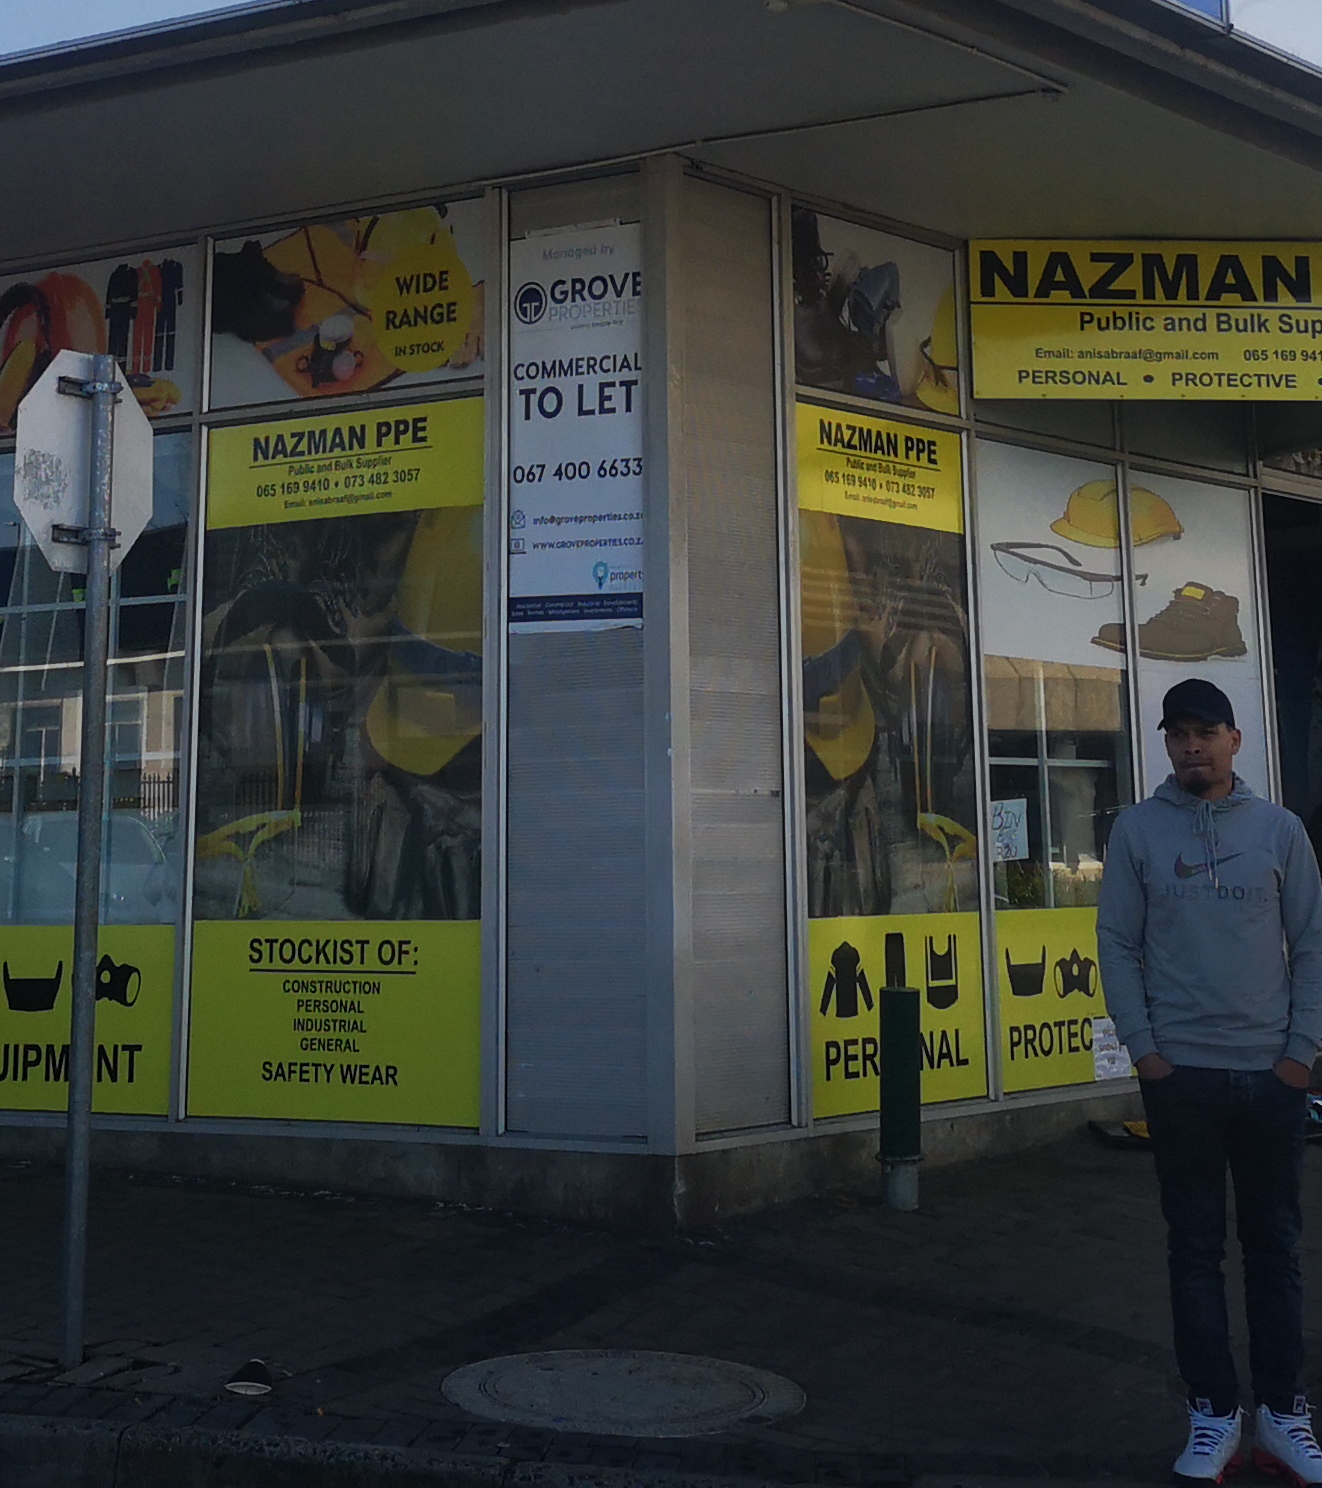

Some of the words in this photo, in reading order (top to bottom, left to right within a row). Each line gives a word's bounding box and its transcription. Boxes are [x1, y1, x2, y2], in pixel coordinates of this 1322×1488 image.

[542, 244, 597, 261] Managed
[600, 243, 615, 256] by
[395, 270, 449, 296] WIDE
[550, 271, 641, 305] GROVE
[980, 250, 1312, 304] NAZMAN
[385, 302, 458, 331] RANGE
[1079, 311, 1155, 332] Public
[1163, 313, 1206, 332] and
[1216, 313, 1270, 333] Bulk
[394, 344, 407, 357] IN
[410, 340, 445, 356] STOCK
[1035, 348, 1073, 360] Email:
[1077, 348, 1219, 362] anisabraaf@gmail.com
[1243, 349, 1268, 361] 065
[1273, 350, 1296, 361] 169
[513, 352, 642, 381] COMMERCIAL
[1018, 369, 1128, 386] PERSONAL
[1172, 372, 1297, 389] PROTECTIVE
[519, 385, 563, 421] TO
[577, 379, 639, 417] LET
[253, 424, 366, 462] NAZMAN
[376, 416, 428, 448] PPE
[819, 418, 899, 459] NAZMAN
[904, 435, 938, 465] PPE
[288, 463, 315, 476] Public
[317, 461, 333, 473] and
[335, 459, 353, 471] Bulk
[356, 455, 392, 470] Supplier
[513, 463, 546, 483] 067
[553, 461, 590, 481] 400
[597, 457, 643, 479] 6633
[256, 483, 277, 498] 065
[281, 482, 300, 495] 169
[303, 478, 330, 493] 9410
[344, 475, 365, 489] 073
[368, 472, 389, 486] 482
[393, 468, 421, 483] 3057
[858, 475, 876, 490] 9410
[885, 480, 900, 494] 073
[532, 537, 643, 550] WWW.GROVEPROPERTIES.CO.Z
[610, 570, 643, 583] propert
[1218, 885, 1245, 900] DO
[248, 938, 369, 965] STOCKIST
[377, 939, 419, 967] OF:
[282, 979, 381, 996] CONSTRUCTION
[296, 998, 365, 1014] PERSONAL
[293, 1017, 367, 1034] INDUSTRIAL
[300, 1037, 360, 1053] GENERAL
[825, 1028, 969, 1081] PERNAL
[261, 1060, 336, 1085] SAFETY
[340, 1064, 399, 1087] WEAR
